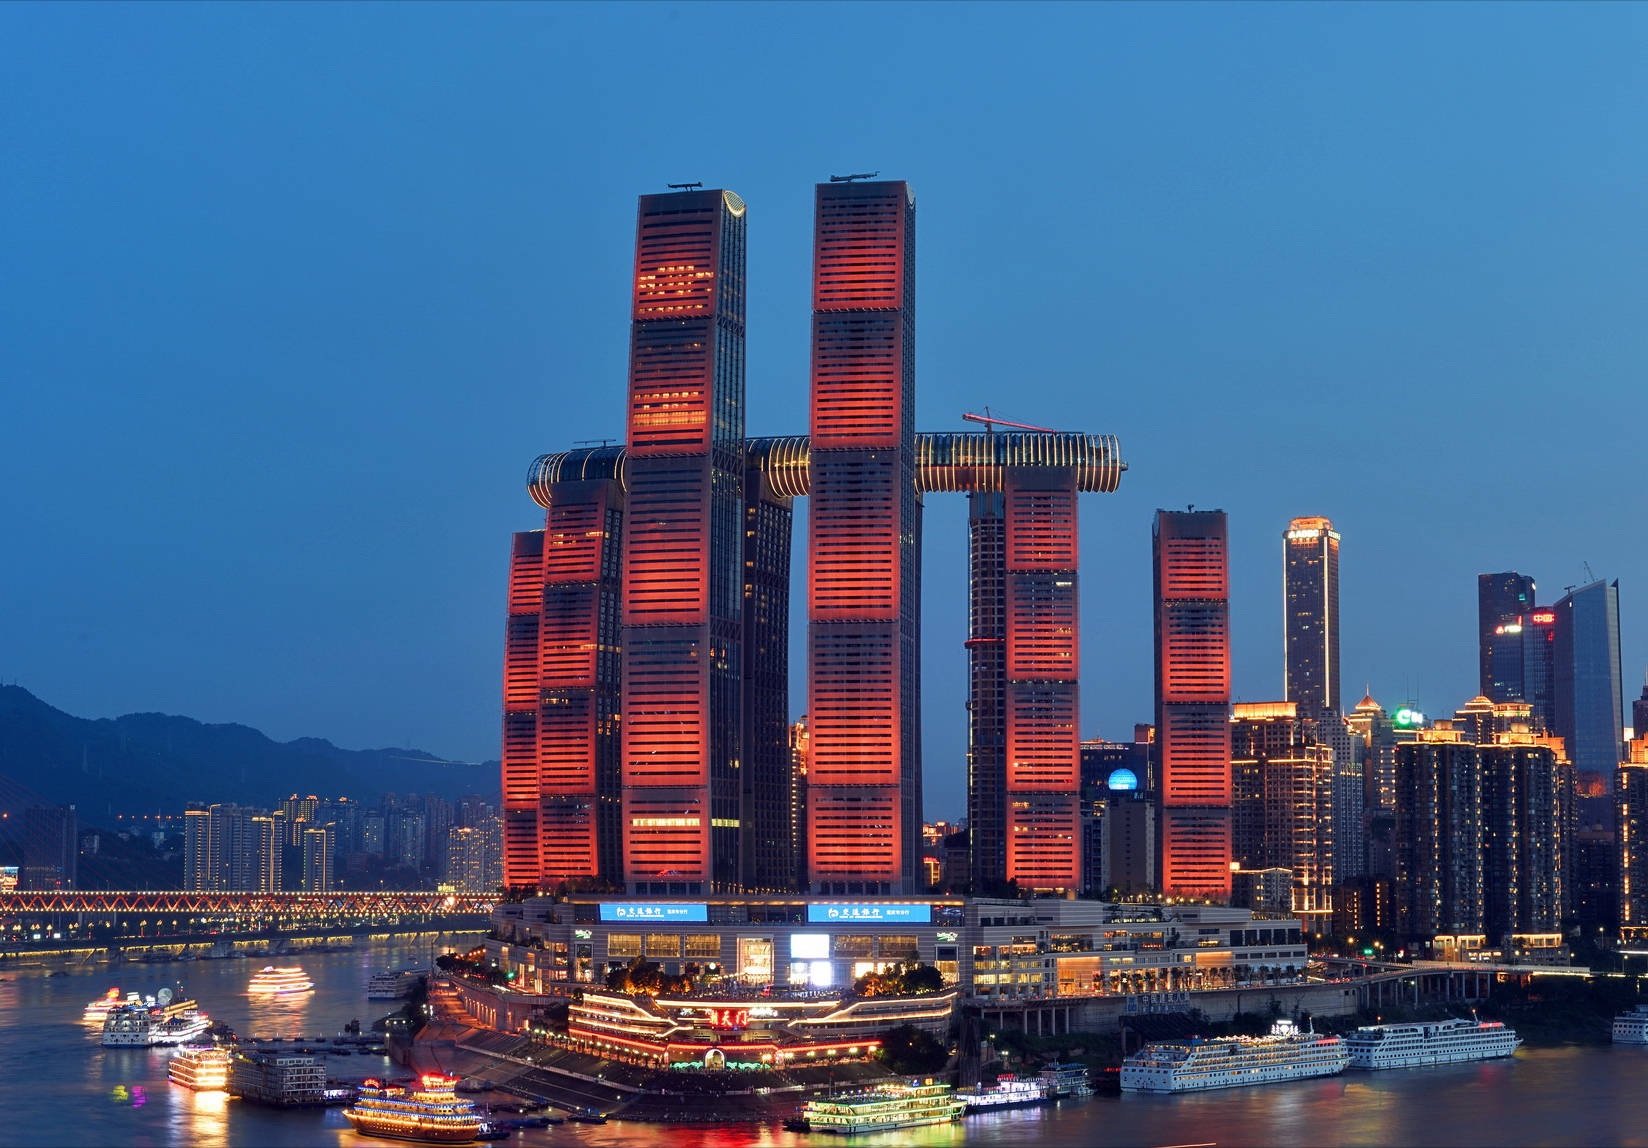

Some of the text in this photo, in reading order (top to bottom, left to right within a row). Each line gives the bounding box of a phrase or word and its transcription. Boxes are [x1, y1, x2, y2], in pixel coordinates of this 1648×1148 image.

[1533, 614, 1555, 623] 中国
[710, 1010, 747, 1026] 朝天门
